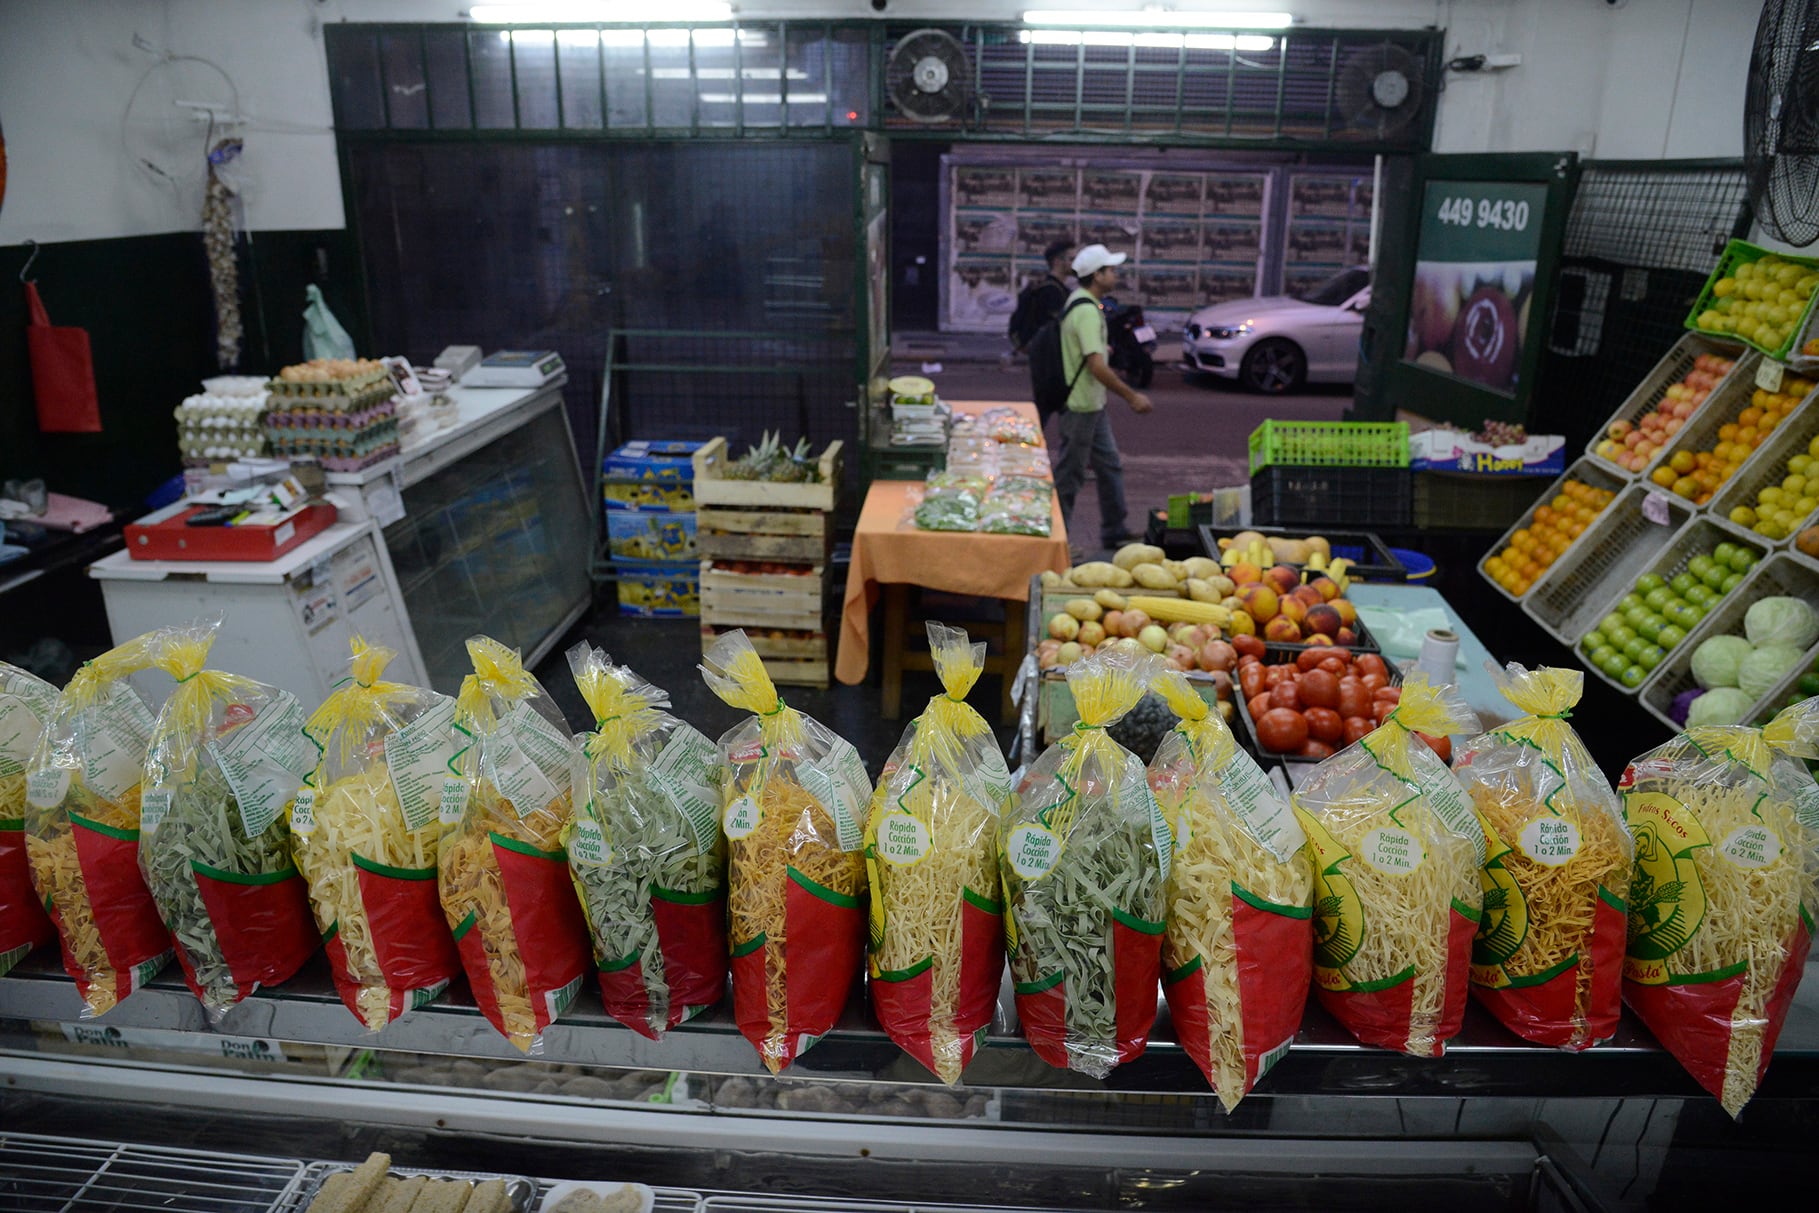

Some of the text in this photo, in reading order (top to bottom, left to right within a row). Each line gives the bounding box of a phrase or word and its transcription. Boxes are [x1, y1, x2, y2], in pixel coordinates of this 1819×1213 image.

[1437, 197, 1529, 231] 449 9430
[736, 818, 752, 830] Min.
[889, 820, 916, 834] Rápida
[888, 832, 916, 844] Cocción
[1025, 832, 1051, 847] Rápida
[1379, 832, 1409, 846] Rápida
[896, 845, 902, 854] 2
[903, 846, 921, 856] Min.
[1022, 844, 1049, 858] Cocción
[1378, 843, 1408, 857] Cocción
[1549, 846, 1554, 856] 2
[1556, 847, 1574, 856] Min.
[1739, 849, 1746, 858] 2
[1747, 851, 1766, 863] Min.
[1028, 857, 1034, 868] 2
[1386, 856, 1392, 864] 2
[1394, 856, 1412, 868] Min.
[221, 1040, 250, 1051] Don
